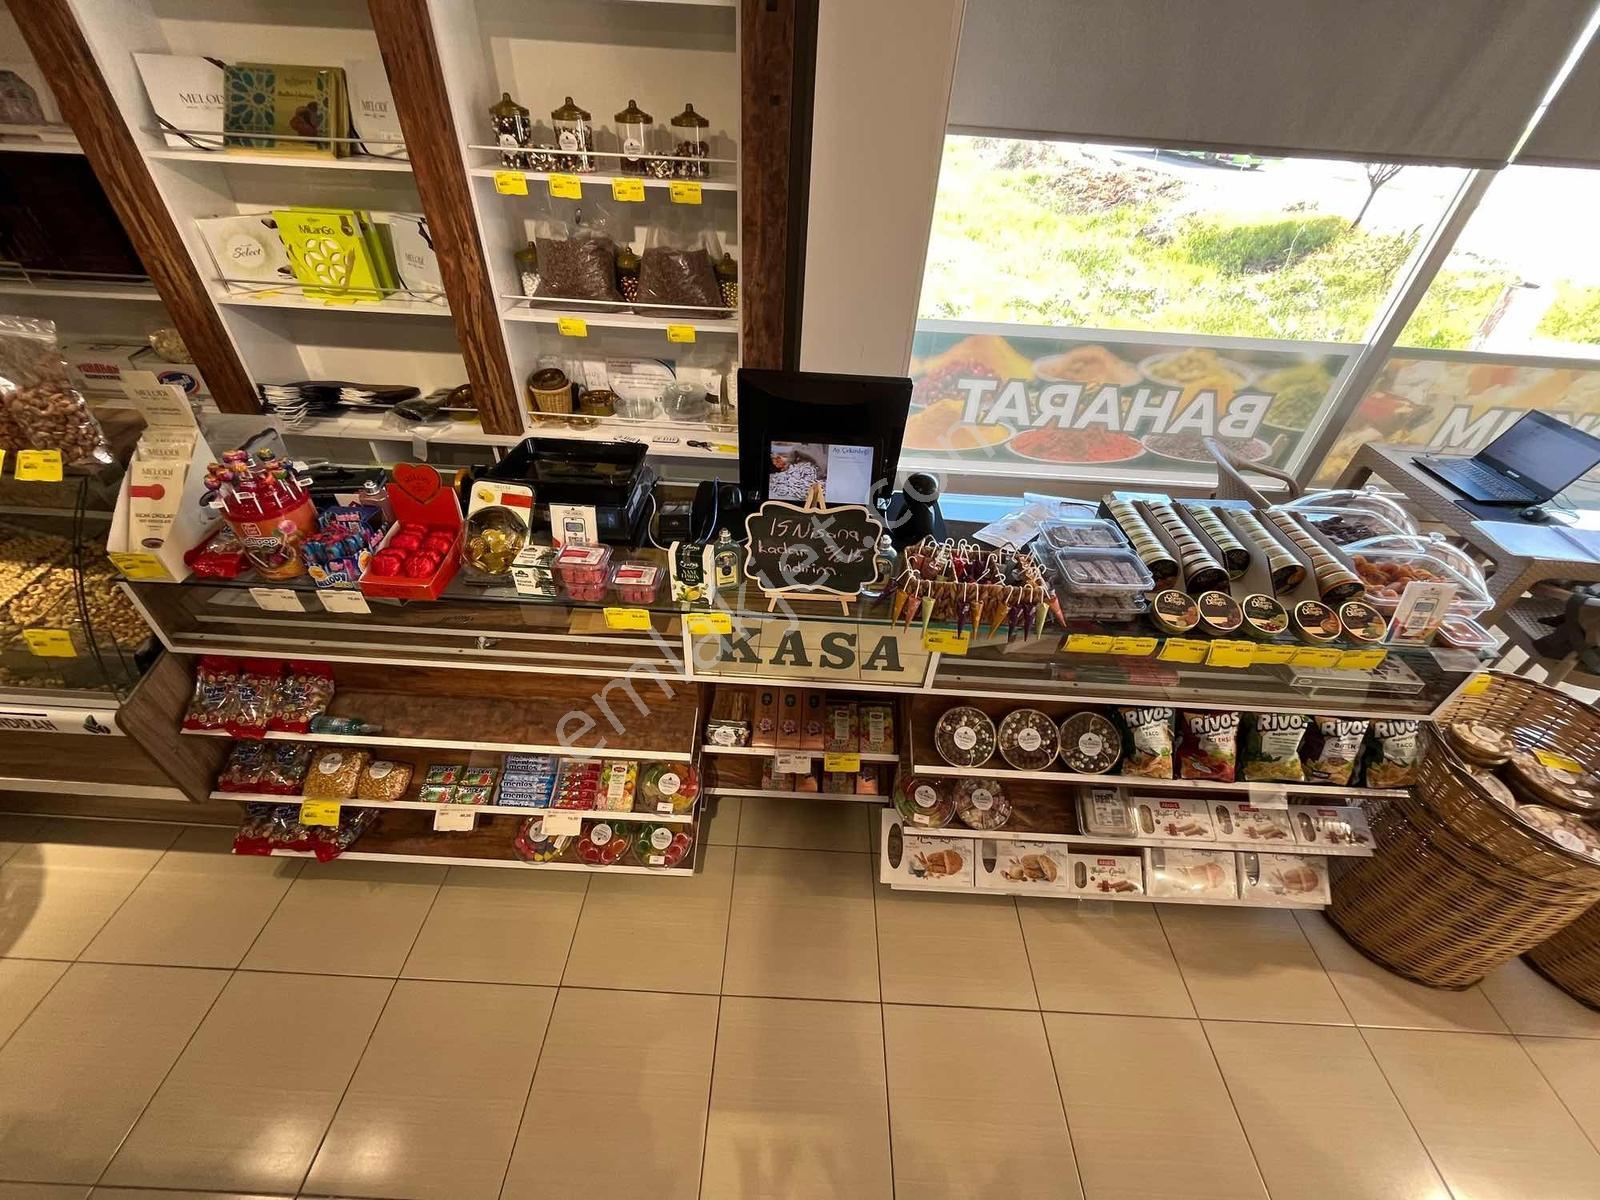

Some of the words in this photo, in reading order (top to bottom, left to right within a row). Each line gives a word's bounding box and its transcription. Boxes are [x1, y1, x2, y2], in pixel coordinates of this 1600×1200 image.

[179, 91, 224, 105] MELOD
[232, 245, 262, 259] Select
[717, 626, 905, 673] KASA
[508, 763, 538, 772] mentos
[503, 780, 534, 788] mentos
[502, 792, 533, 800] mentos
